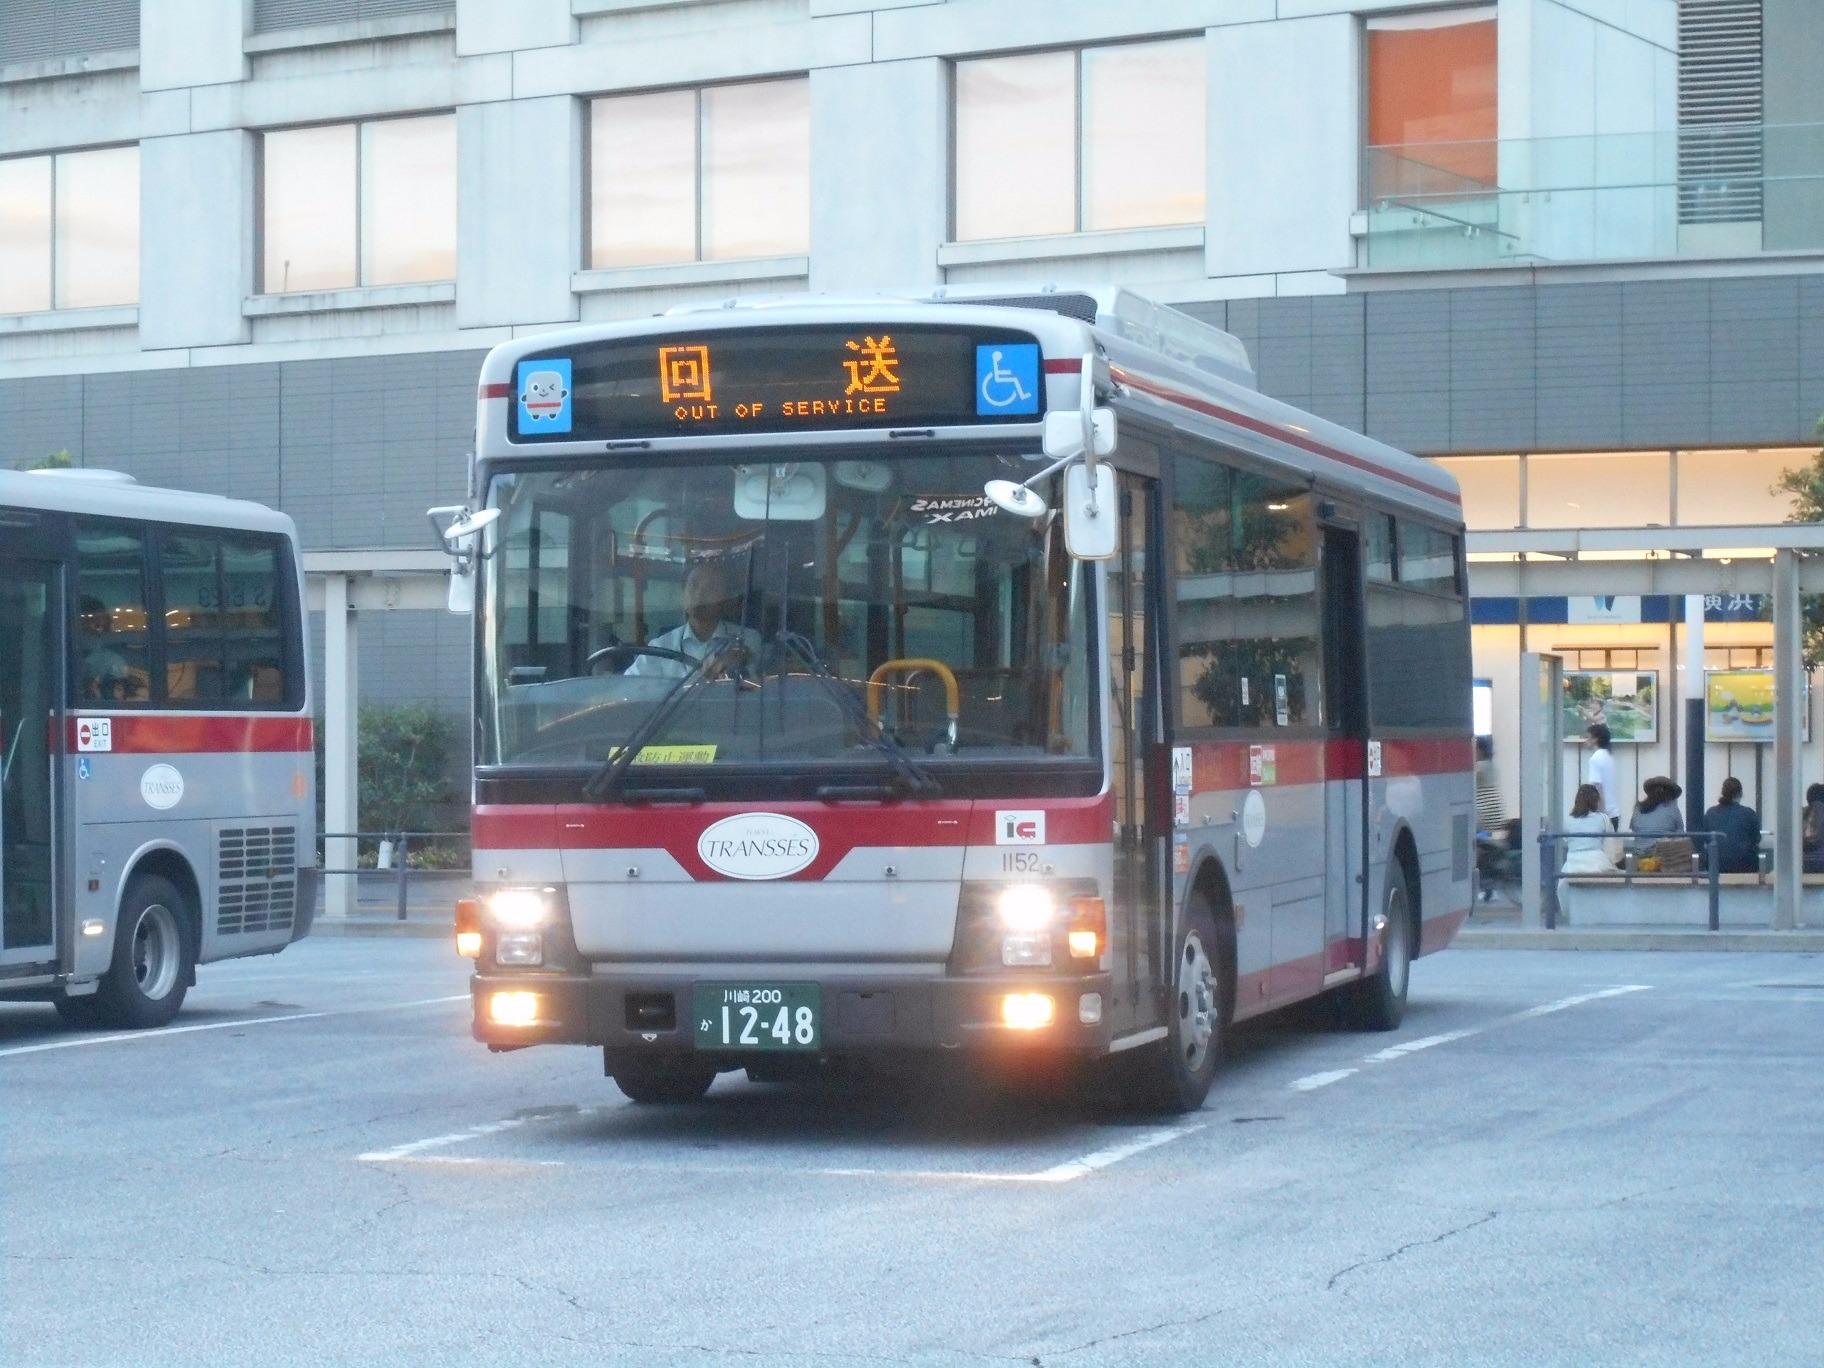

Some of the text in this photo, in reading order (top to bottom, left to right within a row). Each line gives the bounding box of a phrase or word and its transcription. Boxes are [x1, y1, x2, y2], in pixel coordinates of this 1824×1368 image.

[675, 398, 886, 420] OUT OF SERVICE
[92, 722, 109, 737] 出口
[1003, 852, 1040, 873] 1152
[700, 1006, 814, 1045] か 12-48
